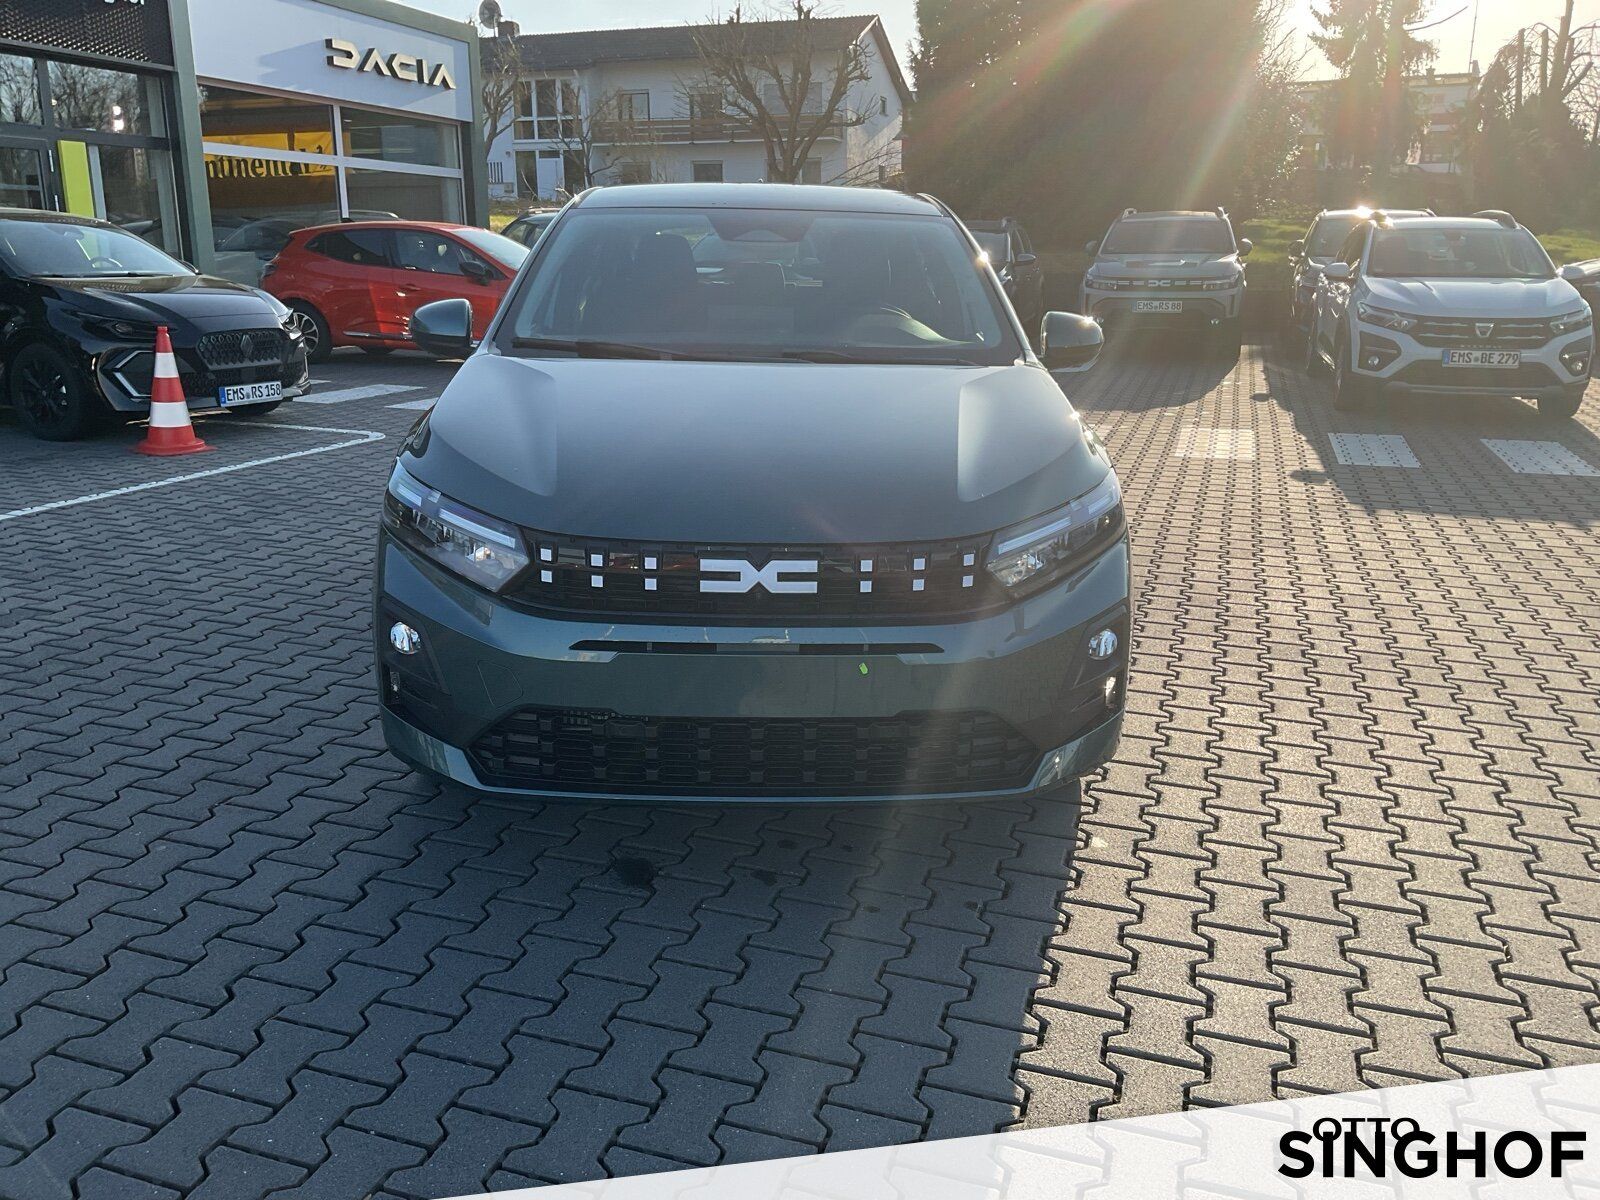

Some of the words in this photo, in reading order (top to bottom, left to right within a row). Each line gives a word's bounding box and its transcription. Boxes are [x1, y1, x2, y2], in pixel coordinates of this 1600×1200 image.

[325, 38, 456, 89] DACIA
[1137, 301, 1154, 310] EMS
[1158, 301, 1170, 310] RS
[1450, 351, 1473, 363] EMS
[1480, 352, 1495, 364] BE
[1498, 353, 1519, 365] 279
[226, 387, 245, 402] EMS
[251, 385, 264, 399] RS
[265, 383, 281, 397] 158
